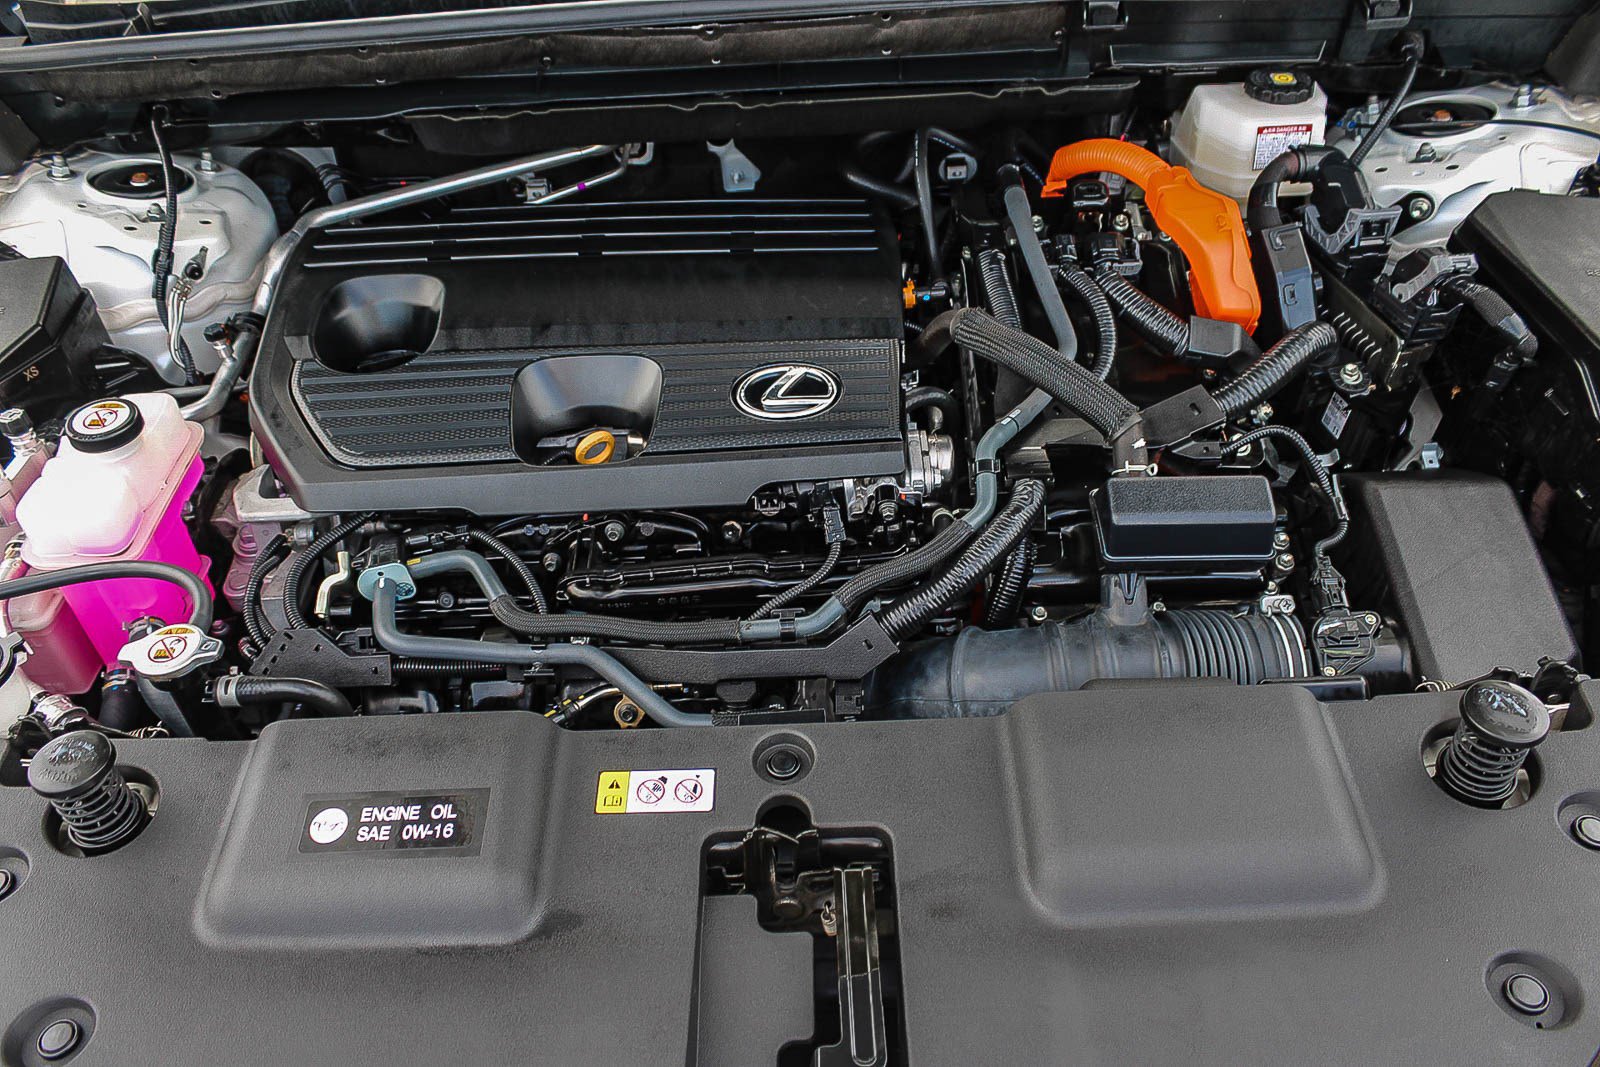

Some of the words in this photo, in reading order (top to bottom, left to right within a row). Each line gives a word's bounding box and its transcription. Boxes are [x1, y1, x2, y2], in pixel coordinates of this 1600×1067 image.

[23, 366, 39, 382] XS
[361, 805, 421, 822] ENGINE
[431, 804, 457, 819] OIL
[357, 825, 391, 842] SAE
[402, 823, 454, 840] 0W-16
